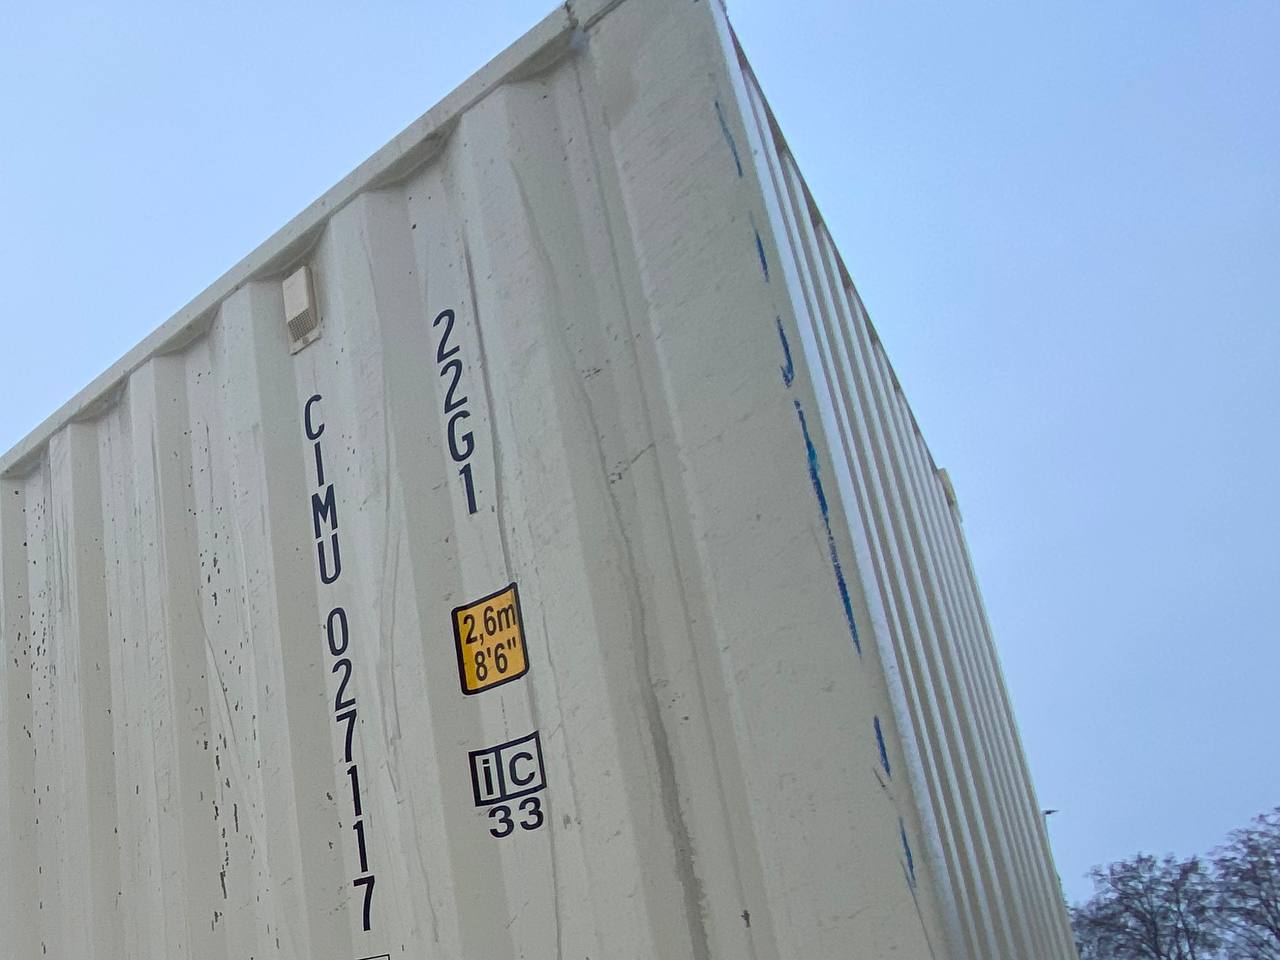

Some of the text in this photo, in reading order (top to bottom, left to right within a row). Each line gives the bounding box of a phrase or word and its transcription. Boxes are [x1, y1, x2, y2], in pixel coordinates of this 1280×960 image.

[432, 308, 477, 515] 22G1
[462, 603, 516, 645] 2,6m
[304, 394, 342, 585] CIMU
[326, 607, 376, 931] 027117
[474, 636, 517, 682] 8'6"
[488, 796, 544, 838] 33
